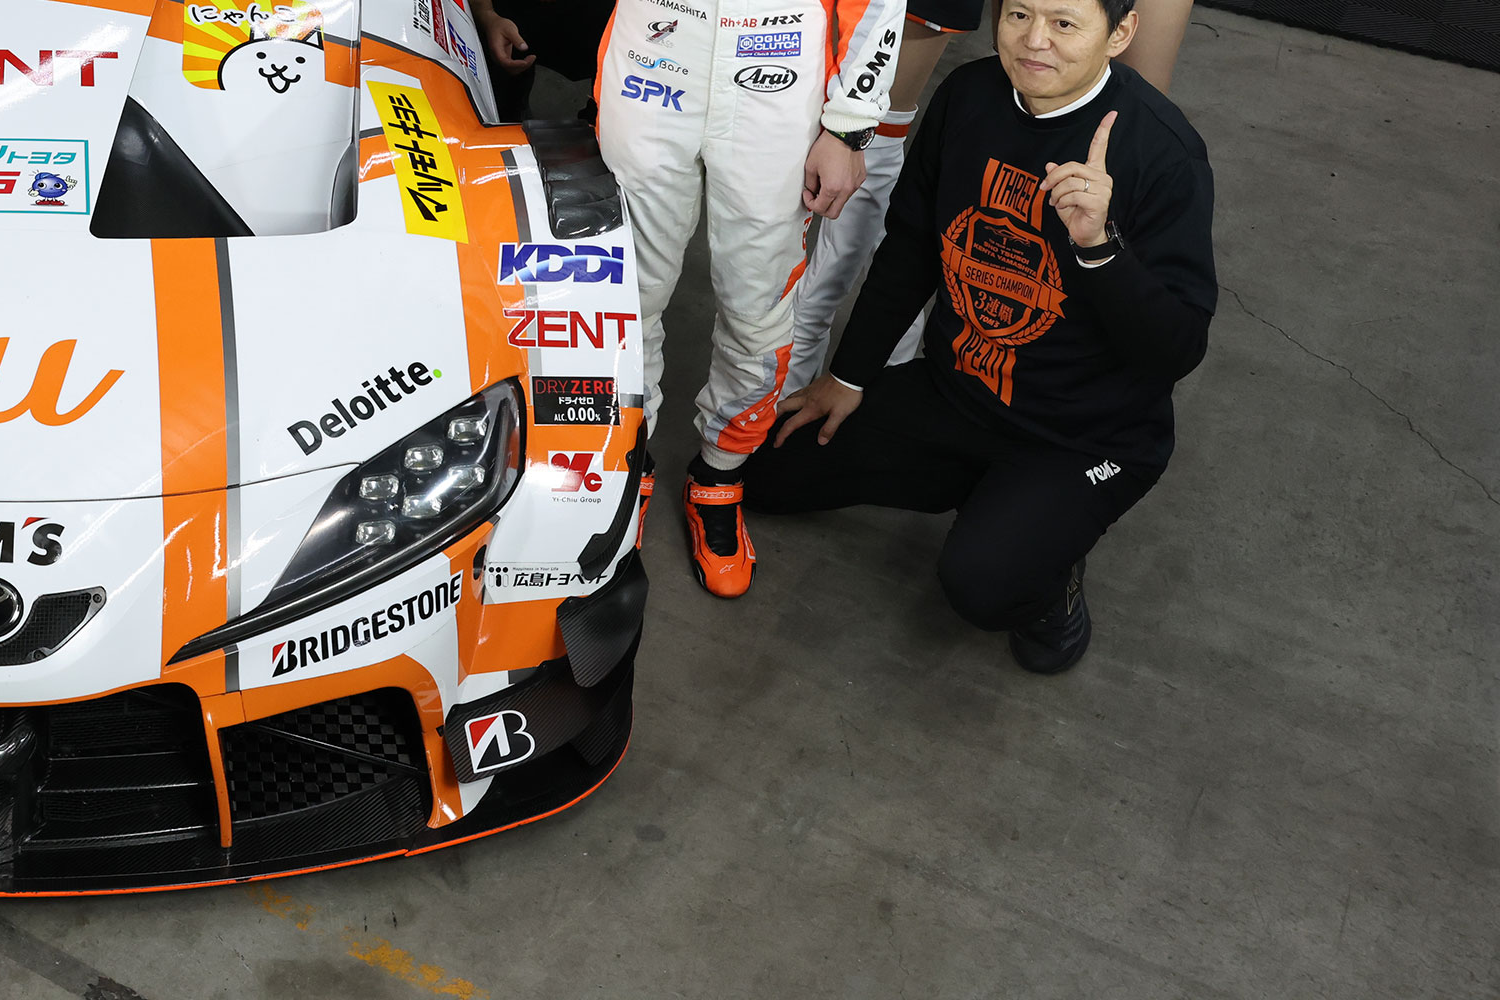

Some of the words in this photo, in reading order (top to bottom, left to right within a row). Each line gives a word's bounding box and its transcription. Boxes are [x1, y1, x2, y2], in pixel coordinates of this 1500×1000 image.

[720, 17, 758, 28] Rh+AB
[761, 13, 804, 27] HRX
[754, 41, 800, 51] CLUTCH
[755, 34, 800, 43] OGURA
[627, 50, 656, 67] Body
[659, 60, 689, 76] Base
[741, 68, 792, 85] Arai
[621, 74, 686, 112] SPK
[995, 167, 1038, 217] THREE
[496, 242, 624, 285] KDDI
[973, 242, 996, 256] KENTA
[997, 253, 1036, 277] YAMASHITA
[983, 240, 999, 251] SHO
[1000, 249, 1030, 264] TSUBOI
[965, 264, 994, 287] SERIES
[995, 276, 1034, 301] CHAMPION
[503, 308, 637, 352] ZENT
[978, 313, 1000, 329] TOM'S
[287, 357, 442, 456] Deloitte.
[558, 396, 594, 405] ドライゼロ
[567, 407, 601, 422] 0.00%
[1086, 459, 1122, 485] TOM'S
[580, 496, 601, 504] Group
[271, 573, 463, 678] BRIDGESTONE
